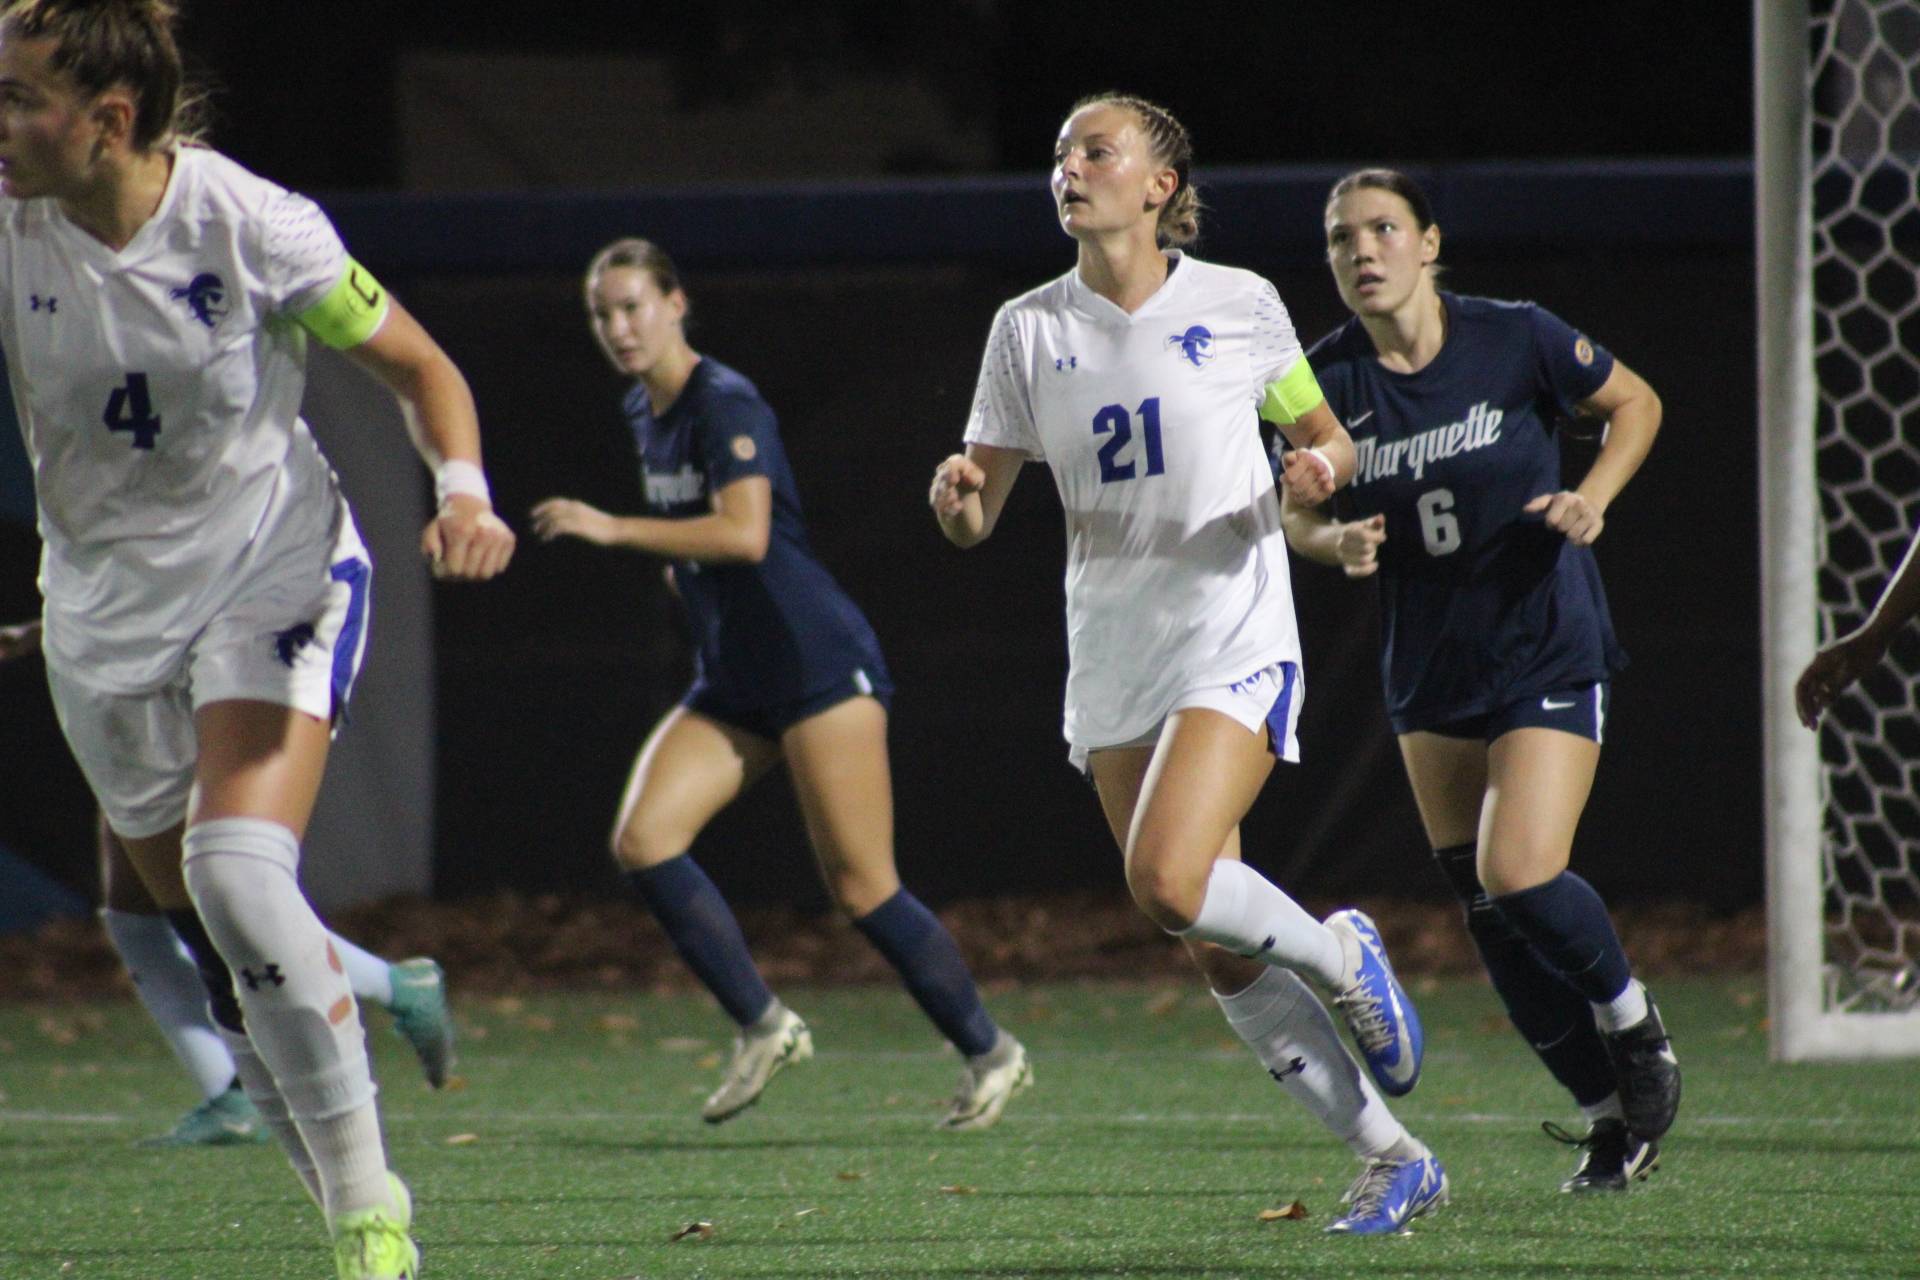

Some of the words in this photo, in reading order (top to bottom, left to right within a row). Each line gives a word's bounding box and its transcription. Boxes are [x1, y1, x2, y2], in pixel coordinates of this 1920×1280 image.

[350, 268, 379, 309] C
[104, 372, 161, 450] 4
[1092, 397, 1165, 484] 21
[1351, 401, 1504, 488] Marquette
[1416, 488, 1462, 557] 6
